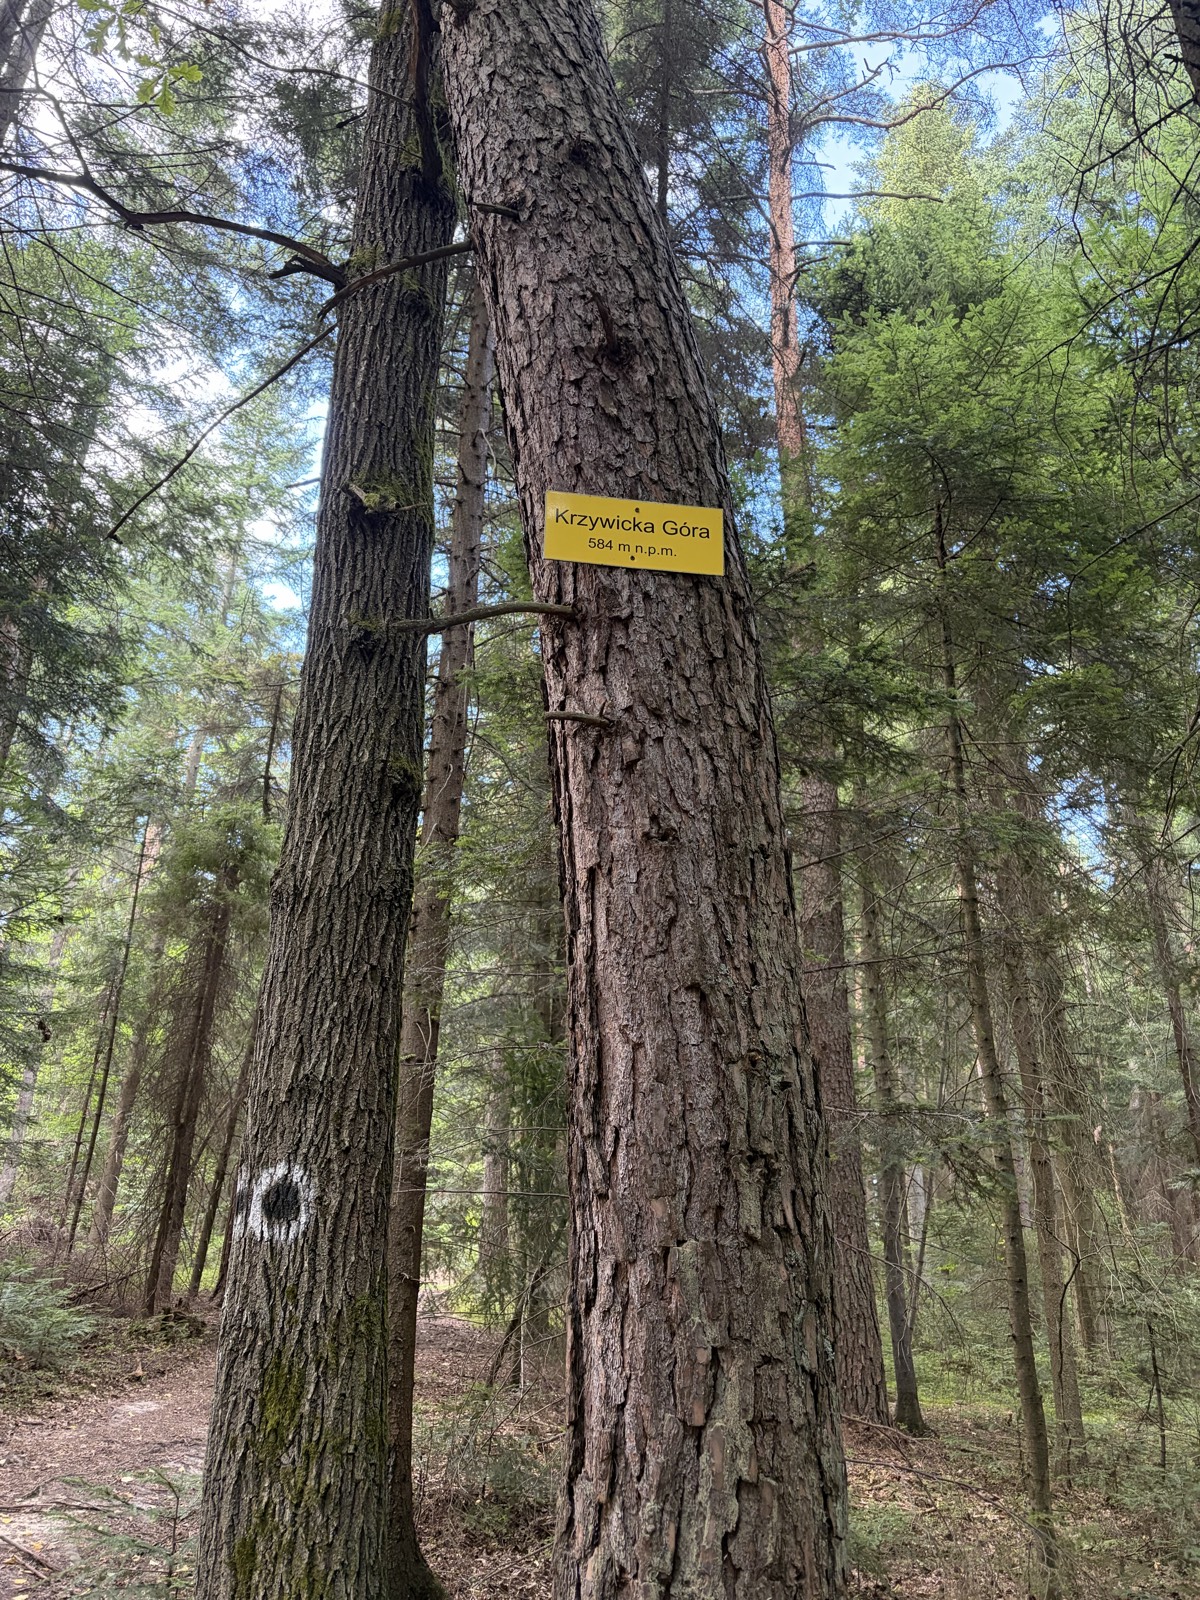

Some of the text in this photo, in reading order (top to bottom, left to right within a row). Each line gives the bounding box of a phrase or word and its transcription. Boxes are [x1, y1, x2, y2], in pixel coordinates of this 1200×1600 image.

[555, 508, 710, 539] Krzywicka Góra
[588, 537, 677, 557] 584 m n.p.m.
